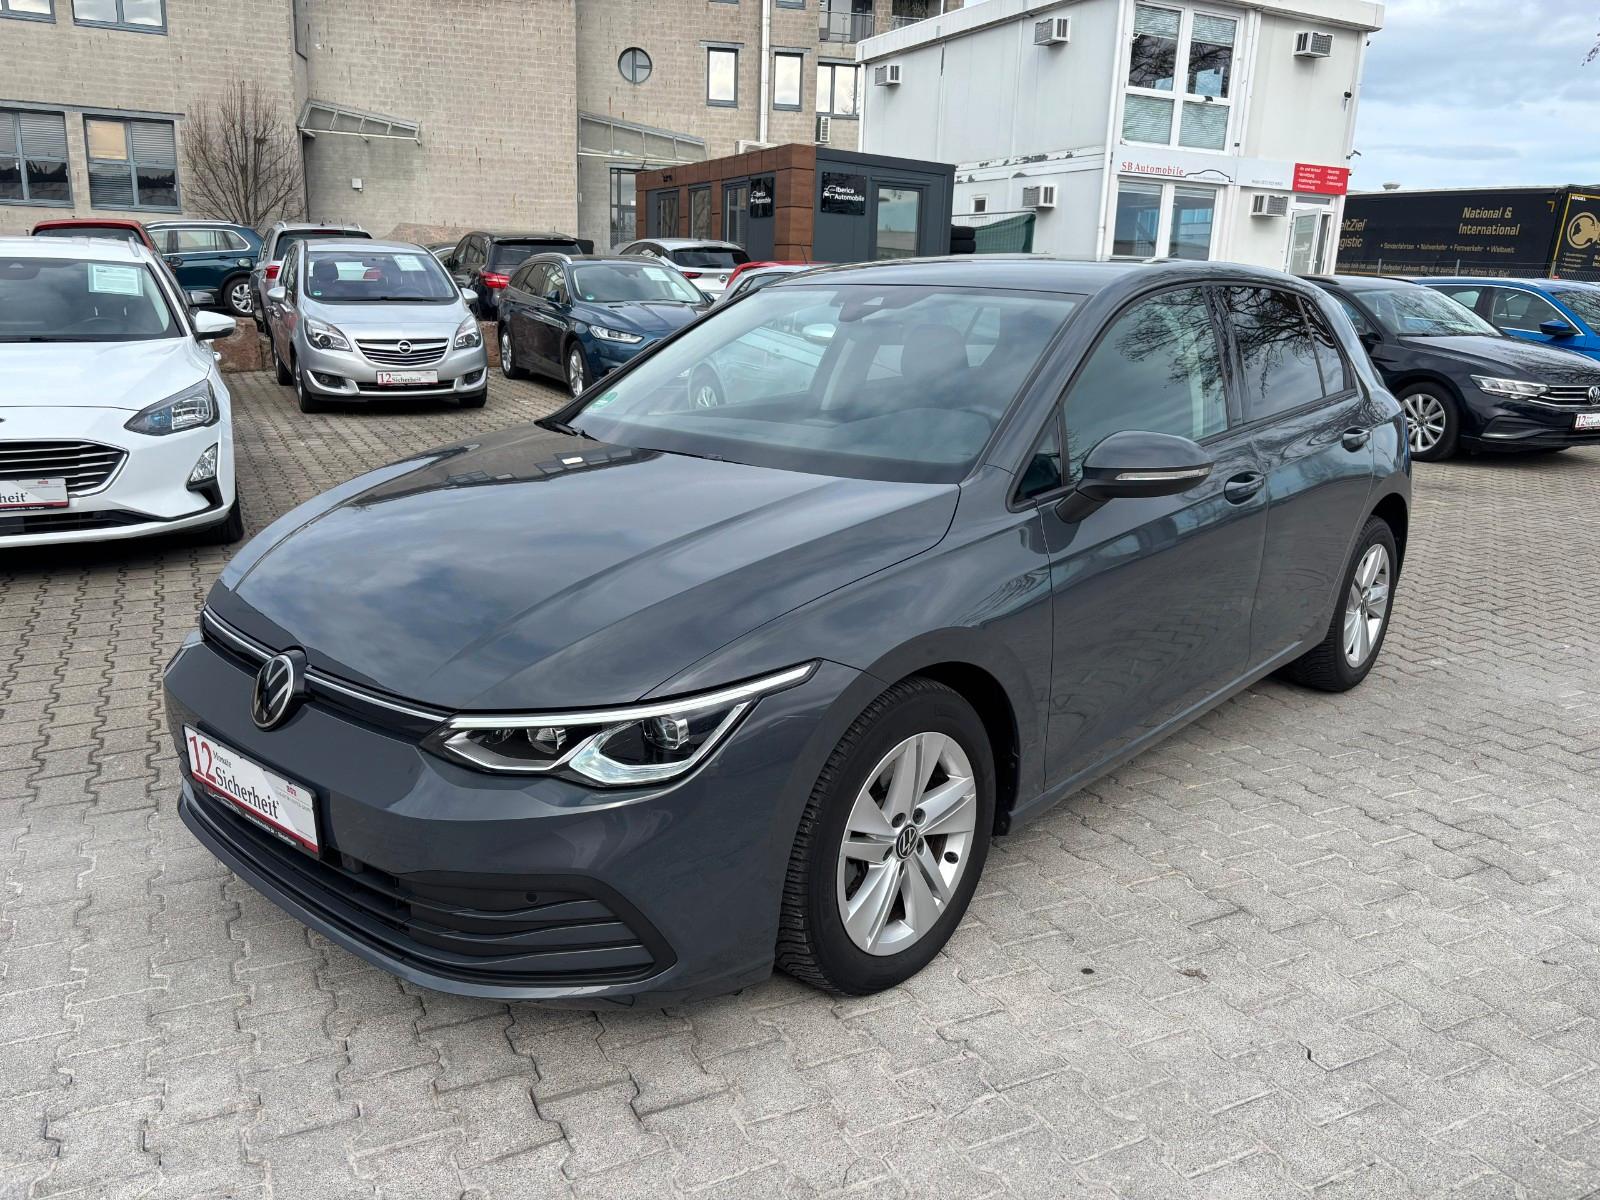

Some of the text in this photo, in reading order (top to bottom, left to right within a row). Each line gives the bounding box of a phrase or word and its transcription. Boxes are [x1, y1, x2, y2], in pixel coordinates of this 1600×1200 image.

[1121, 161, 1184, 175] SB Automobile
[836, 186, 854, 194] Iberica
[834, 193, 865, 202] Automobile
[1462, 207, 1512, 218] National &
[1458, 223, 1520, 235] International
[1339, 234, 1363, 250] gistic
[378, 373, 392, 383] 12
[189, 735, 217, 784] 12
